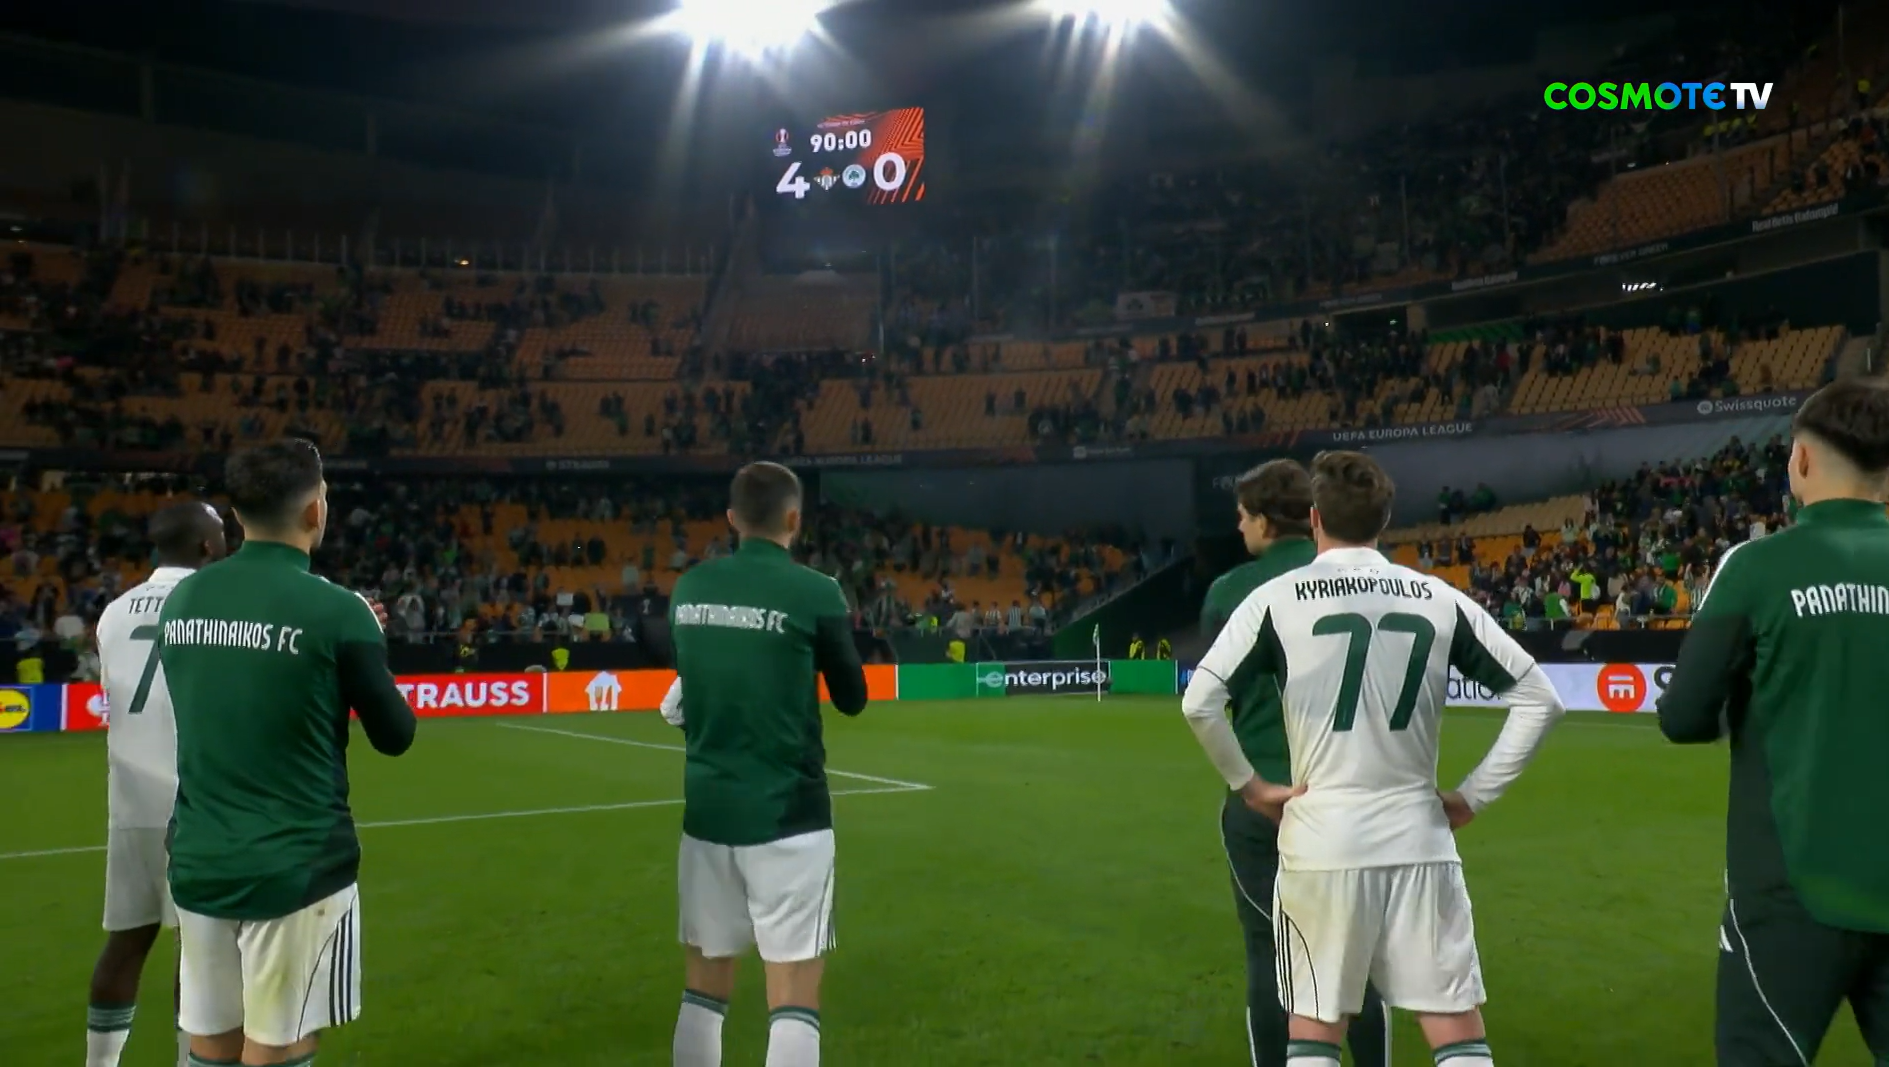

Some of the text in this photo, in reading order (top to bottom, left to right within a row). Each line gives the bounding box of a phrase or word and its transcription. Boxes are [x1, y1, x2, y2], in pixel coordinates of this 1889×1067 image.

[810, 129, 872, 153] 90:00
[776, 152, 907, 199] 4 0
[1714, 395, 1797, 412] Swissquote
[1333, 422, 1473, 442] UEFA EUROPA LEAGUE
[1295, 577, 1433, 600] KYRIAKOPOULOS
[129, 596, 165, 614] TETT
[164, 618, 303, 655] PANATHINAIKOS FC
[985, 666, 1107, 690] enterprise
[1312, 612, 1436, 732] 77
[395, 680, 530, 709] TRAUSS
